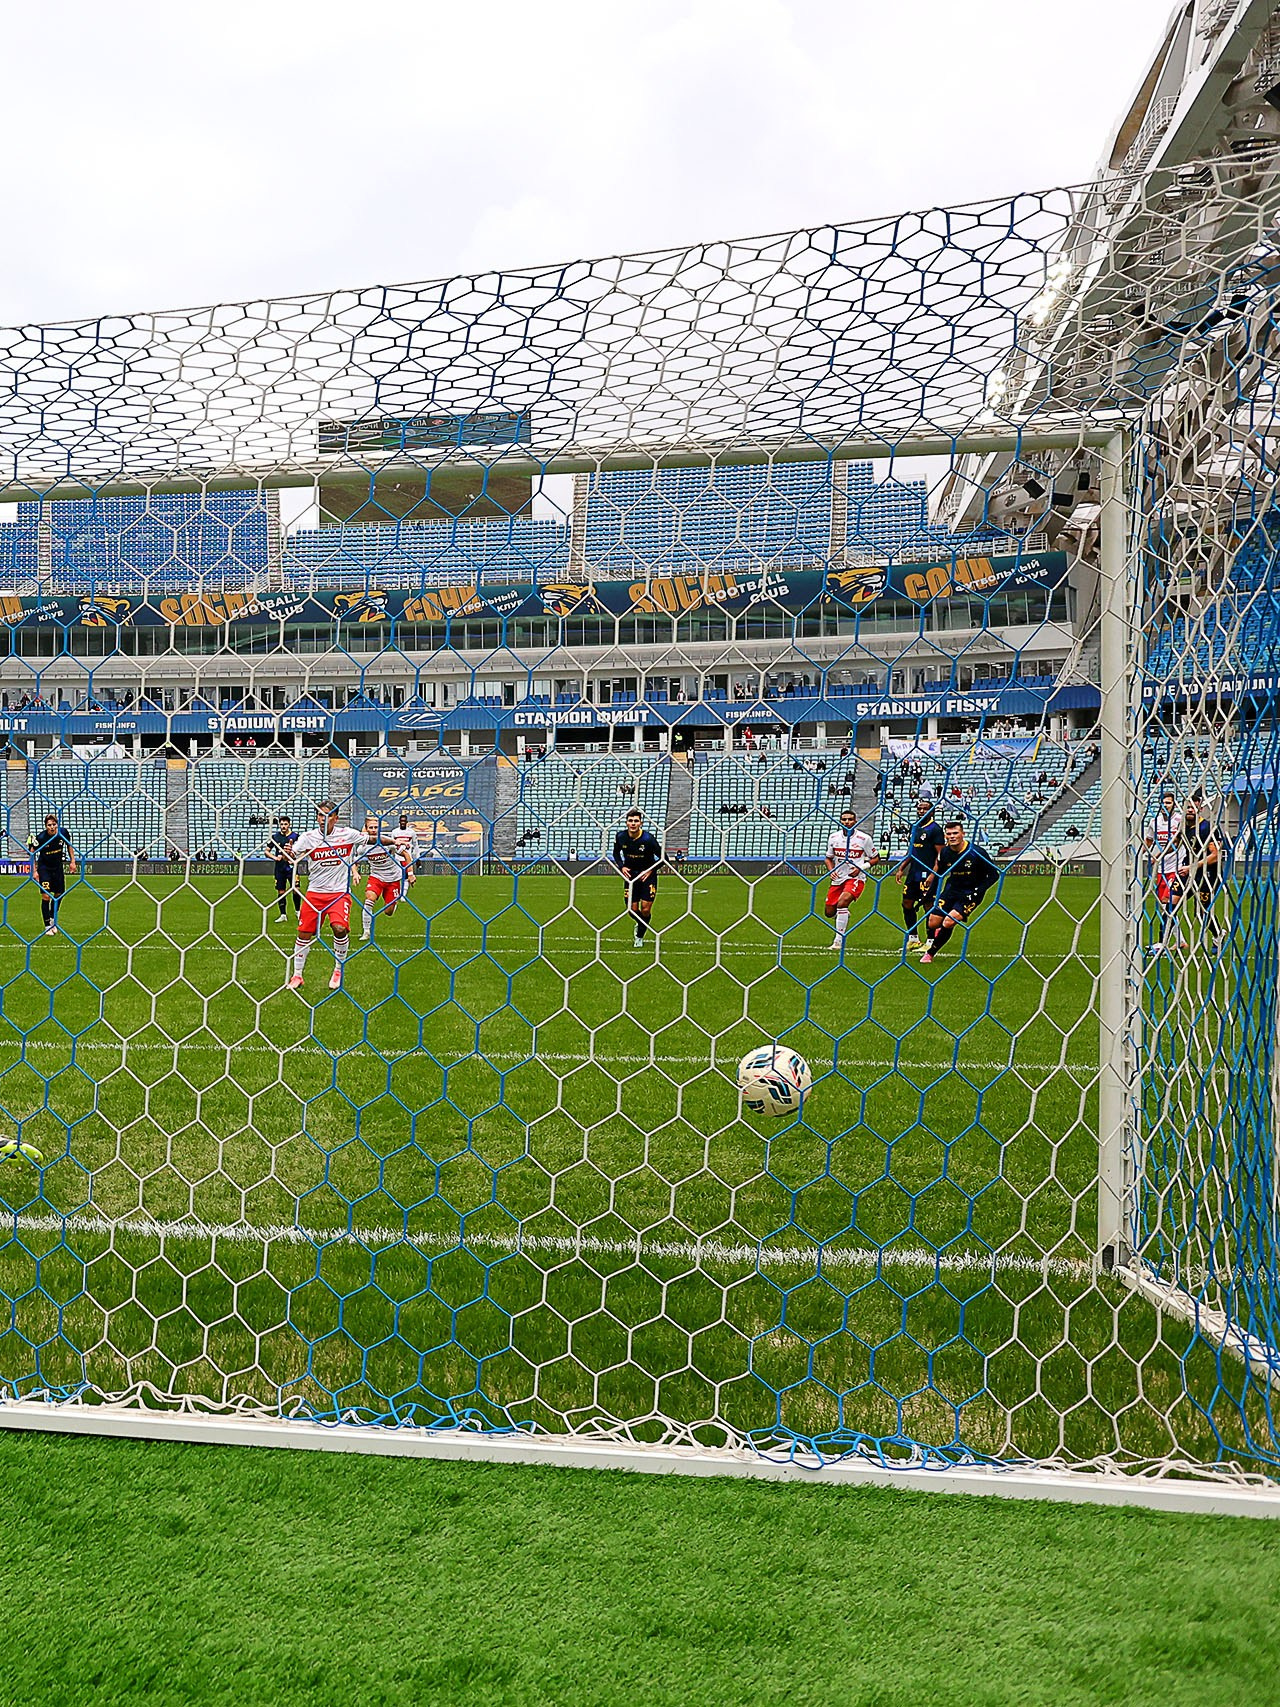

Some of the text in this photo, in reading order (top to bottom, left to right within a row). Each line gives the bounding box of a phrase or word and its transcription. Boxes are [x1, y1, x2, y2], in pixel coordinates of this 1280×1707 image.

[904, 558, 998, 599] СОЧИ
[628, 575, 740, 613] SOCHI
[709, 573, 785, 603] FOOTBALL
[750, 585, 790, 603] CLUB
[160, 593, 261, 626] SOCHI
[230, 594, 301, 619] FOOTBALL
[268, 604, 304, 620] CLUB
[404, 586, 483, 621] СОЧИ
[856, 697, 1001, 716] STADIUM FISHT
[207, 716, 327, 729] STADIUM FISHT
[514, 709, 650, 726] СТАДИОН ФИШТ
[383, 770, 464, 778] ФК «СОЧИ»
[379, 786, 465, 798] БАРС
[8, 864, 17, 874] НА
[343, 901, 349, 914] 5
